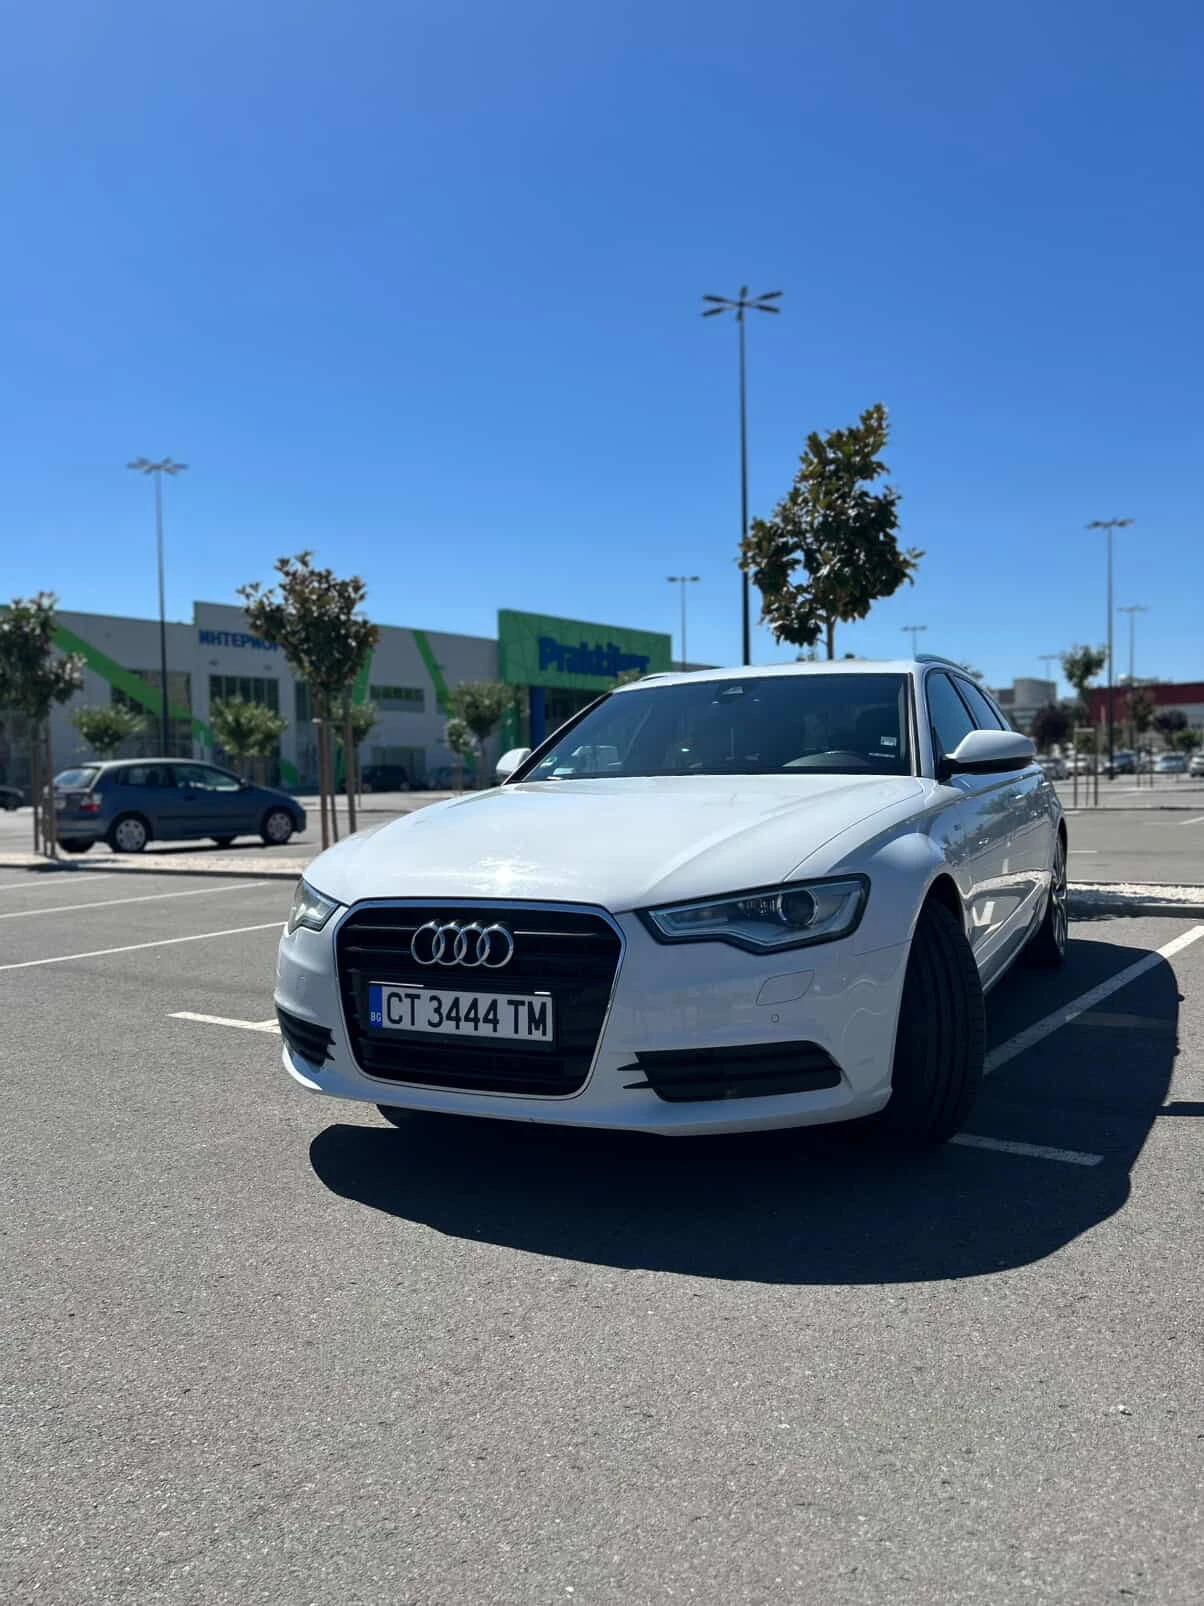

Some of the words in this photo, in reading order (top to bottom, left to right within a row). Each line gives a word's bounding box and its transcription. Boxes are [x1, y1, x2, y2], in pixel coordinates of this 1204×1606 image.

[370, 1011, 382, 1022] BG
[386, 991, 421, 1027] CT
[427, 995, 500, 1033] 3444
[507, 1000, 548, 1037] TM
